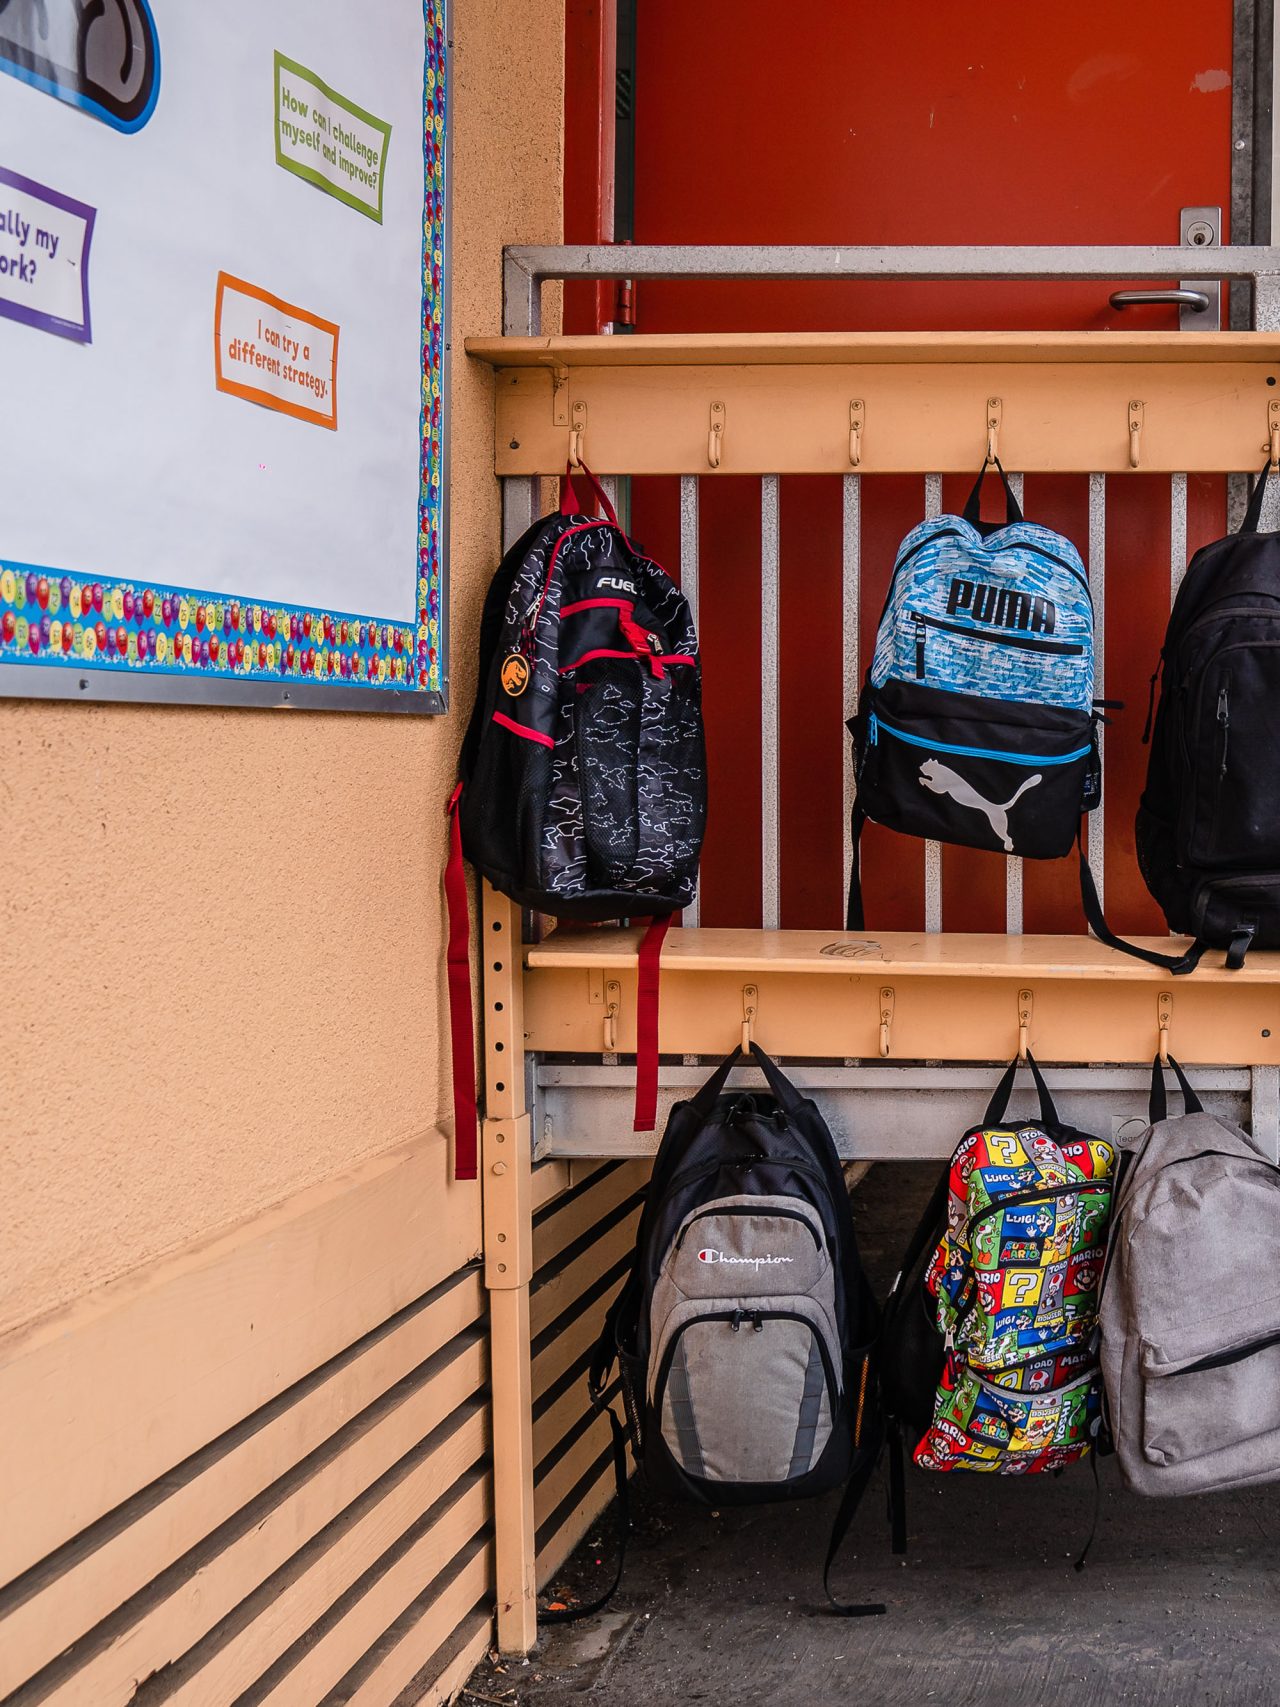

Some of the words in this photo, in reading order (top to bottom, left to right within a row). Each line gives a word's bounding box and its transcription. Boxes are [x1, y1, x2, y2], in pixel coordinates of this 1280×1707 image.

[282, 86, 309, 118] How
[312, 109, 327, 132] can
[332, 123, 379, 168] challenge
[281, 120, 321, 152] myself
[322, 143, 337, 166] and
[338, 149, 378, 190] improve?
[35, 227, 59, 259] my
[258, 319, 262, 340] I
[264, 327, 281, 349] can
[282, 334, 299, 362] try
[303, 345, 310, 360] a
[228, 337, 281, 377] different
[282, 364, 328, 399] strategy.
[597, 577, 637, 594] FUEL
[946, 578, 1055, 634] PUMA
[985, 1174, 1015, 1182] LUIGI
[1006, 1214, 1035, 1224] LUIGI
[1001, 1249, 1039, 1260] MARIO
[1005, 1240, 1037, 1251] SUPER
[698, 1248, 794, 1272] Champion
[1071, 1248, 1104, 1266] MARIO
[1048, 1260, 1068, 1274] TOAD
[995, 1315, 1016, 1330] LUIGI
[969, 1421, 1009, 1440] MARIO
[977, 1414, 1007, 1430] SUPER
[1053, 1400, 1072, 1443] YOSHI
